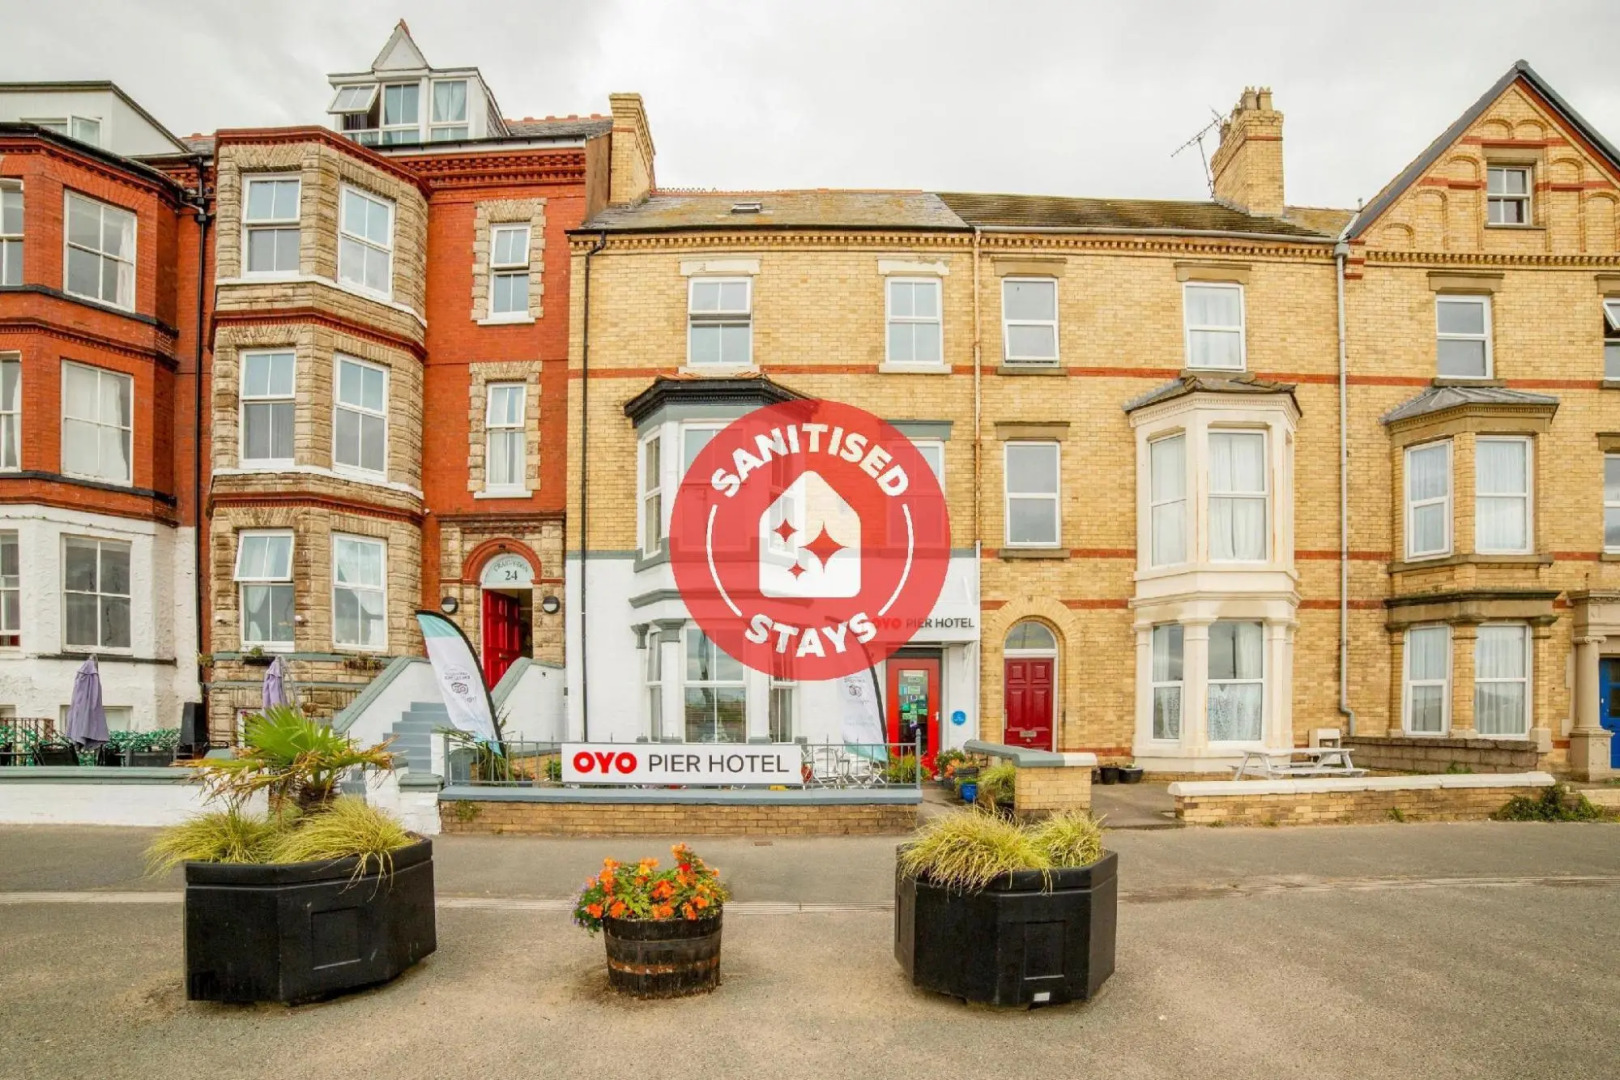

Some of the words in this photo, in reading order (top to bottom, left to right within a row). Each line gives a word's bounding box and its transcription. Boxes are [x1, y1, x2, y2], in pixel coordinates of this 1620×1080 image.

[505, 570, 518, 581] 24
[906, 618, 933, 628] PIER
[935, 617, 975, 628] HOTEL
[573, 751, 637, 774] OYO
[649, 754, 701, 773] PIER
[708, 754, 789, 773] HOTEL
